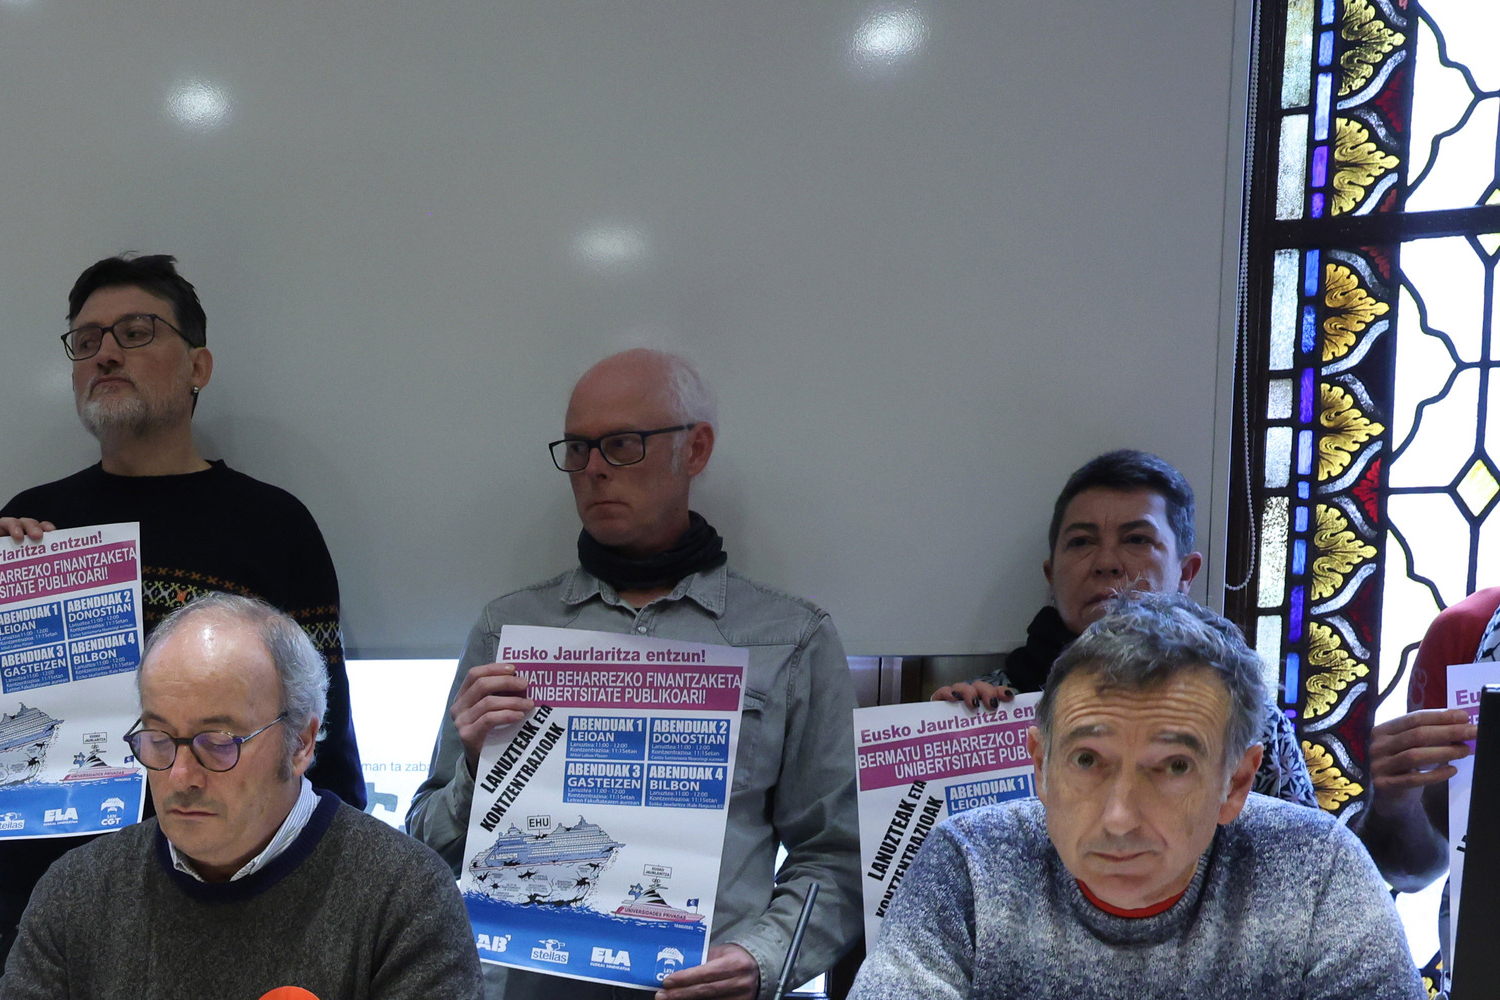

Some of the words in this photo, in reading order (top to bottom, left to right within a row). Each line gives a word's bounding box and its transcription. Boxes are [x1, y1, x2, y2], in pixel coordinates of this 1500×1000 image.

[50, 531, 102, 552] entzun!
[500, 646, 549, 660] Eusko
[553, 647, 641, 661] Jaurlaritza
[646, 648, 707, 662] entzun!
[861, 723, 911, 744] Eusko
[917, 707, 1008, 734] Jaurlaritza
[858, 746, 920, 769] BERMATU
[924, 731, 1015, 758] BEHARREZKO
[361, 762, 386, 771] man
[391, 762, 401, 771] ta
